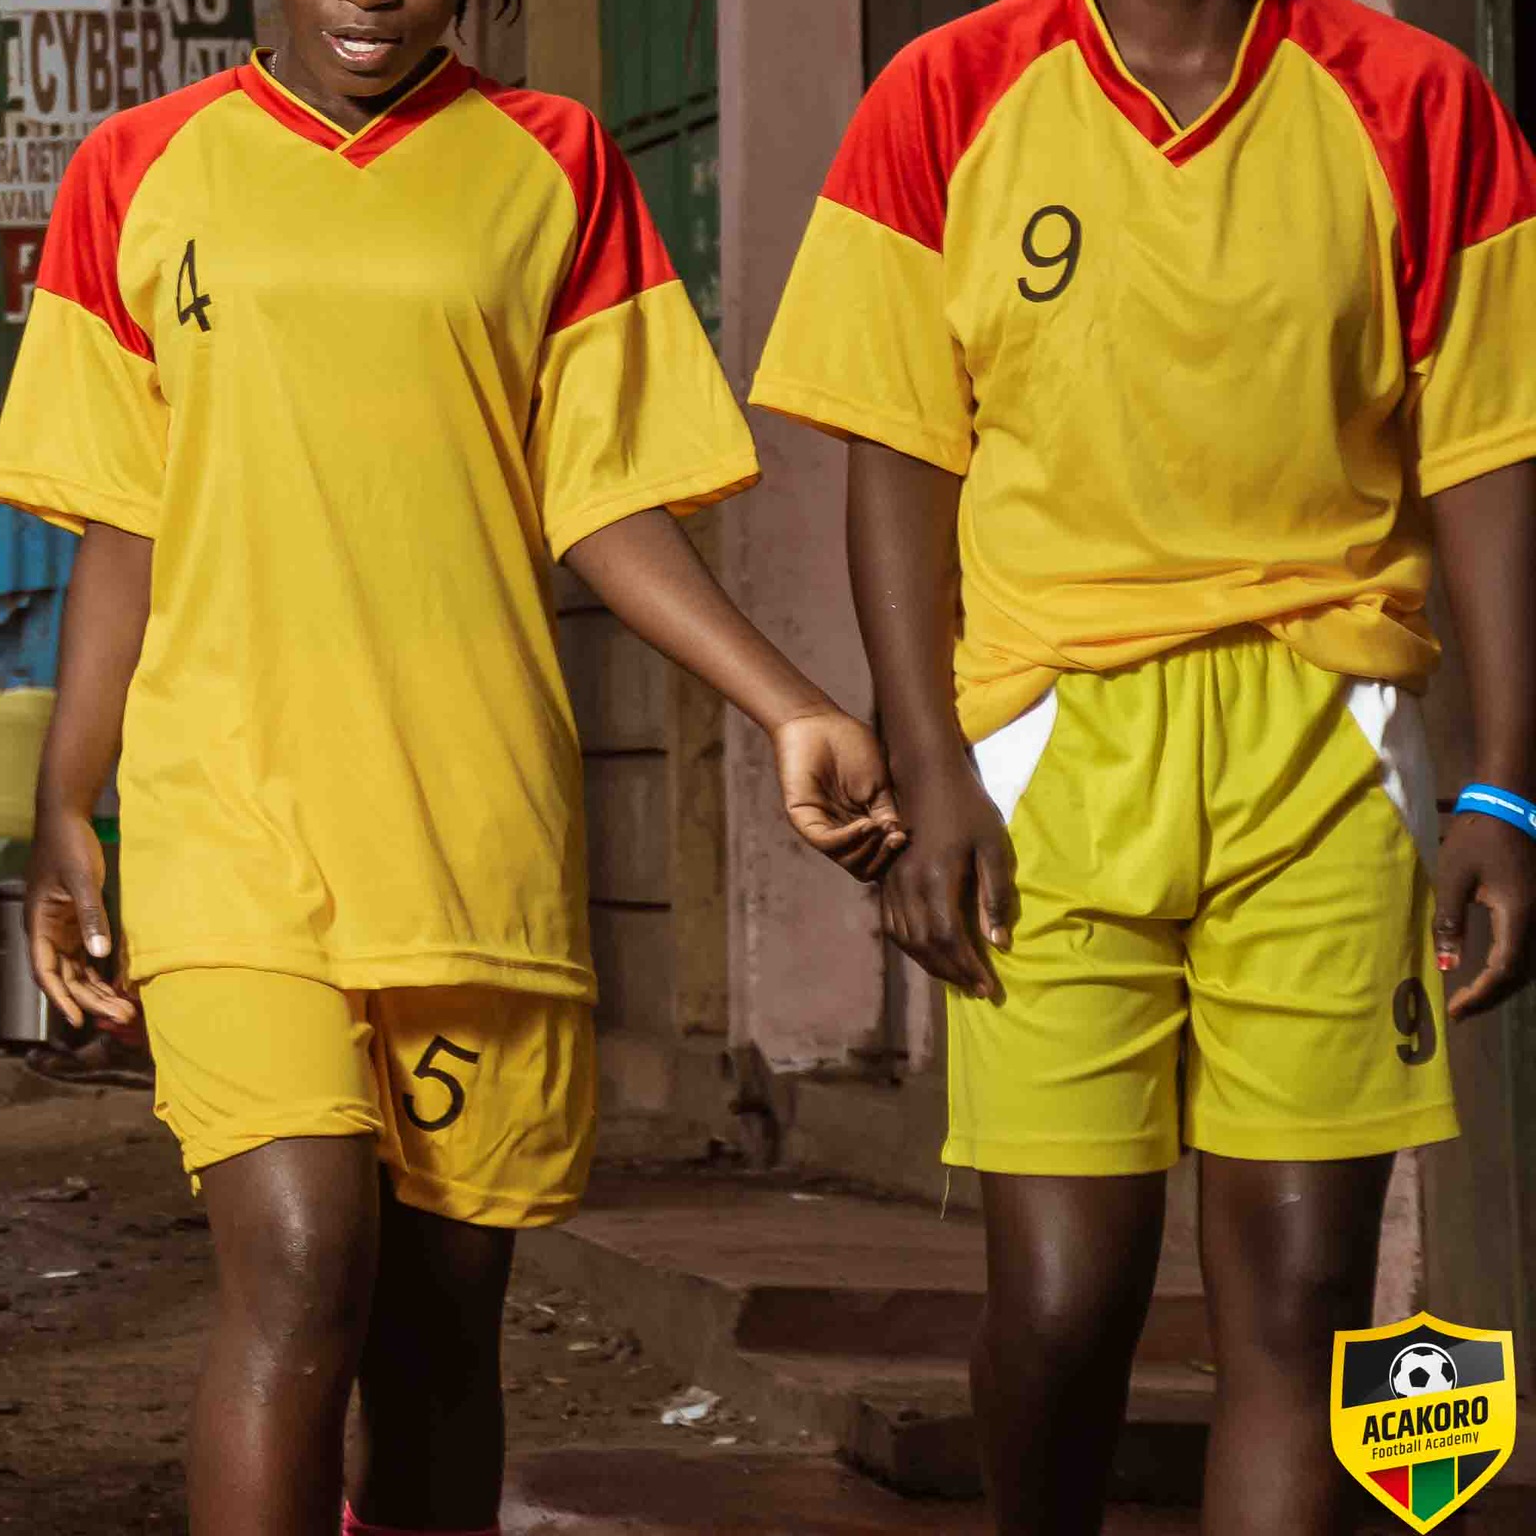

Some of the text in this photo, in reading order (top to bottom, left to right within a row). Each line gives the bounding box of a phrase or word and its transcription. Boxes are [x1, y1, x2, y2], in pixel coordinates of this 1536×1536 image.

[30, 11, 165, 114] CYBER
[177, 239, 211, 332] 4
[1018, 205, 1081, 302] 9
[1393, 976, 1436, 1065] 9
[402, 1034, 480, 1132] 5
